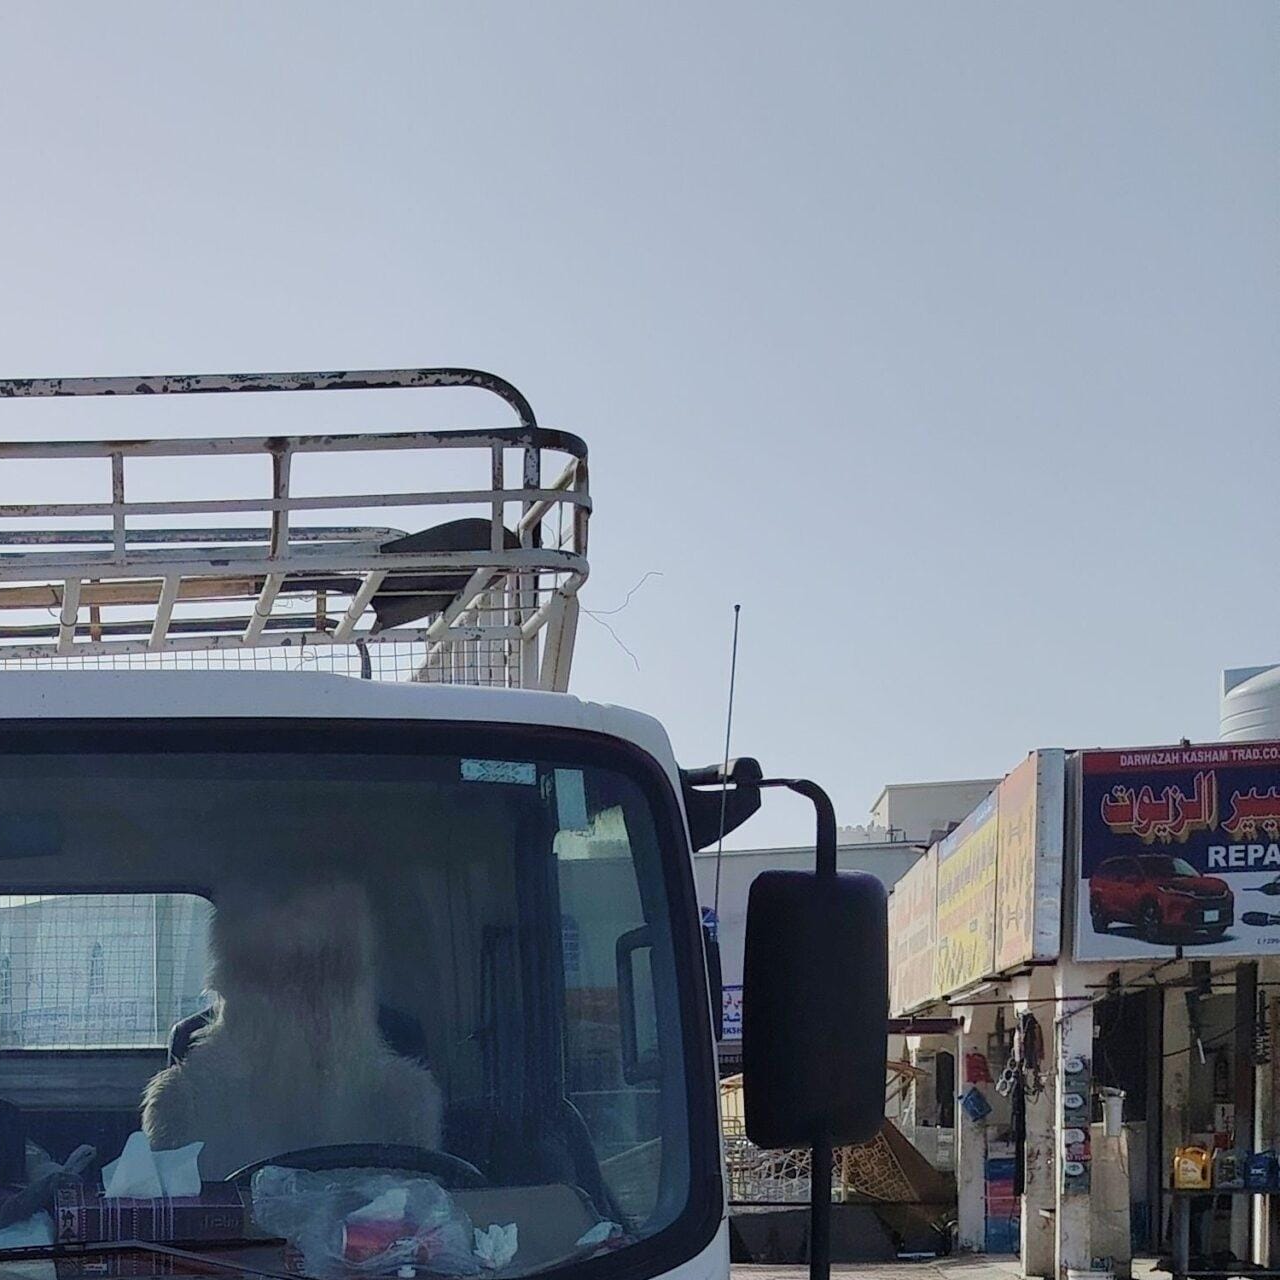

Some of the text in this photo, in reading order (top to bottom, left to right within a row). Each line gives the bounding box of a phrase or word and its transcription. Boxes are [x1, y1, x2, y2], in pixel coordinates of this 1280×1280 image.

[1120, 753, 1180, 767] DARWAZAH
[1182, 750, 1229, 764] KASHAM
[1101, 769, 1217, 837] الزيوت
[1207, 844, 1280, 868] REPA
